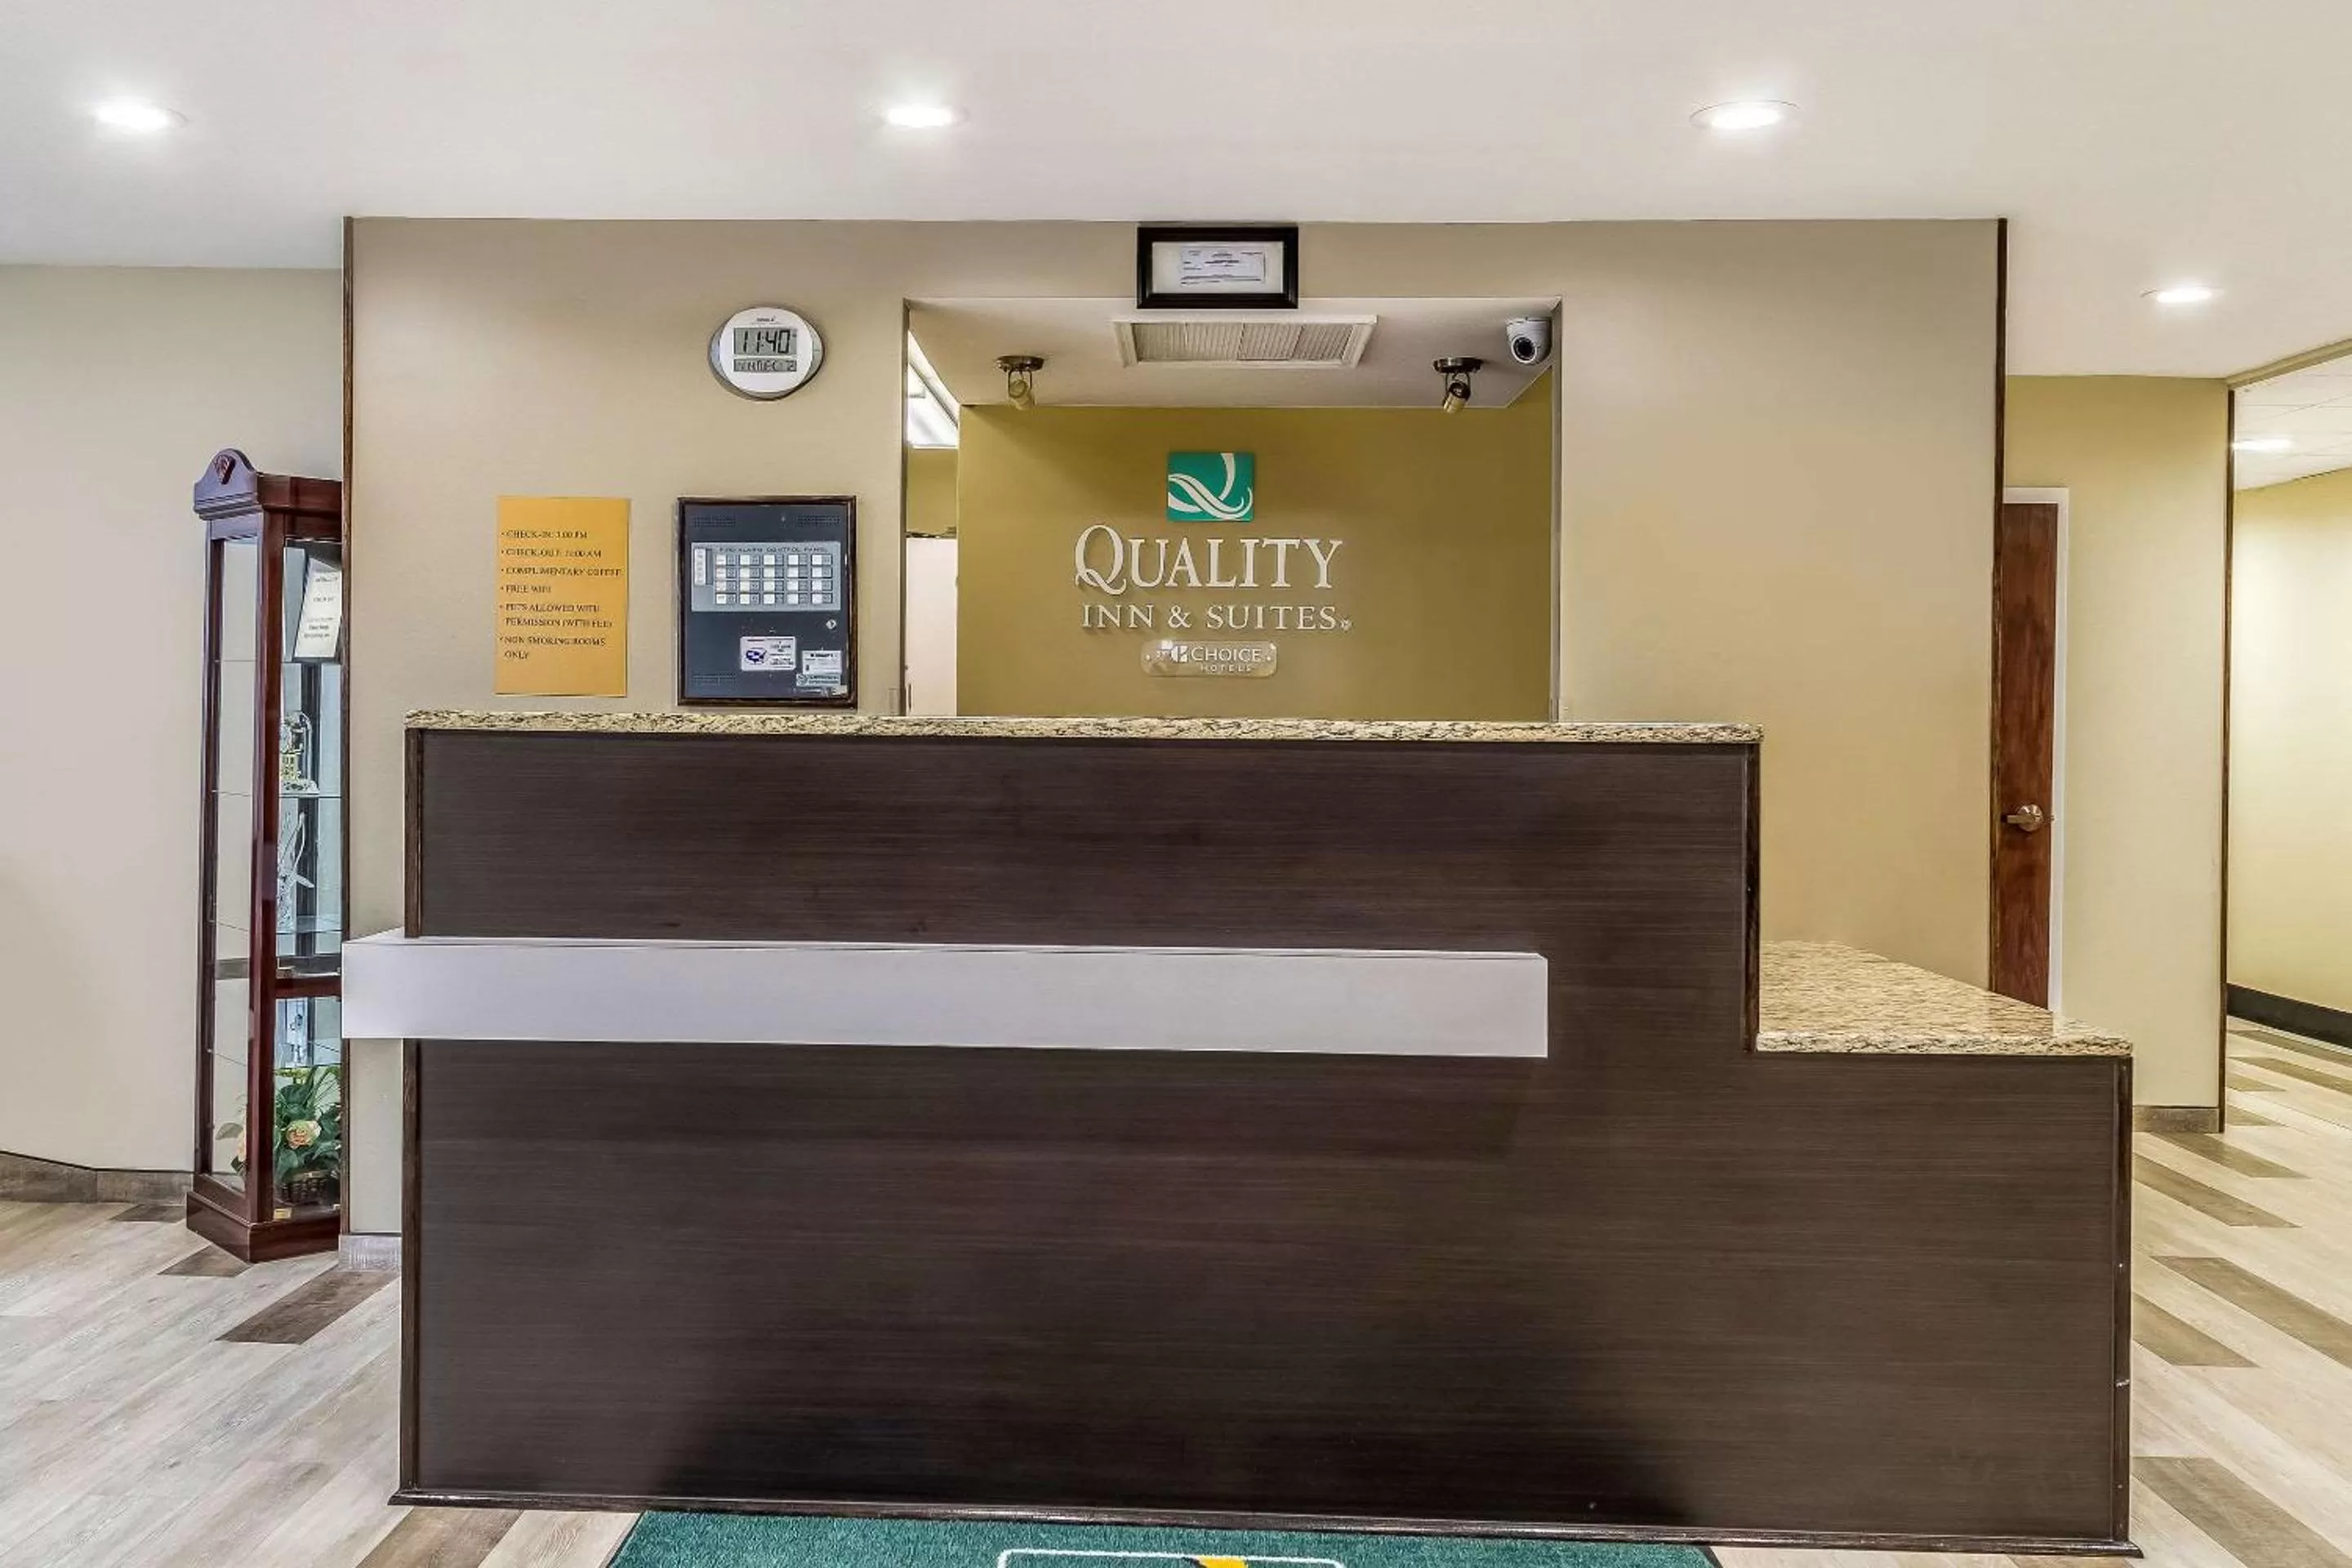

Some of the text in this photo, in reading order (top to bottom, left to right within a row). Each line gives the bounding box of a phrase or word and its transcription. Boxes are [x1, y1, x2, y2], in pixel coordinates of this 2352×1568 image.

[586, 550, 601, 559] AM
[1075, 523, 1343, 595] QUALITY
[506, 585, 529, 593] FREE
[530, 604, 575, 612] ALLOWED
[577, 604, 601, 612] WITH
[1081, 604, 1153, 629] INN
[1168, 605, 1192, 629] &
[506, 617, 560, 626] PERMISSION
[505, 636, 606, 647] NON SMOKING ROOMS
[505, 650, 529, 659] ONLY
[1192, 647, 1263, 662] CHOICE
[1200, 664, 1252, 673] HOTELS
